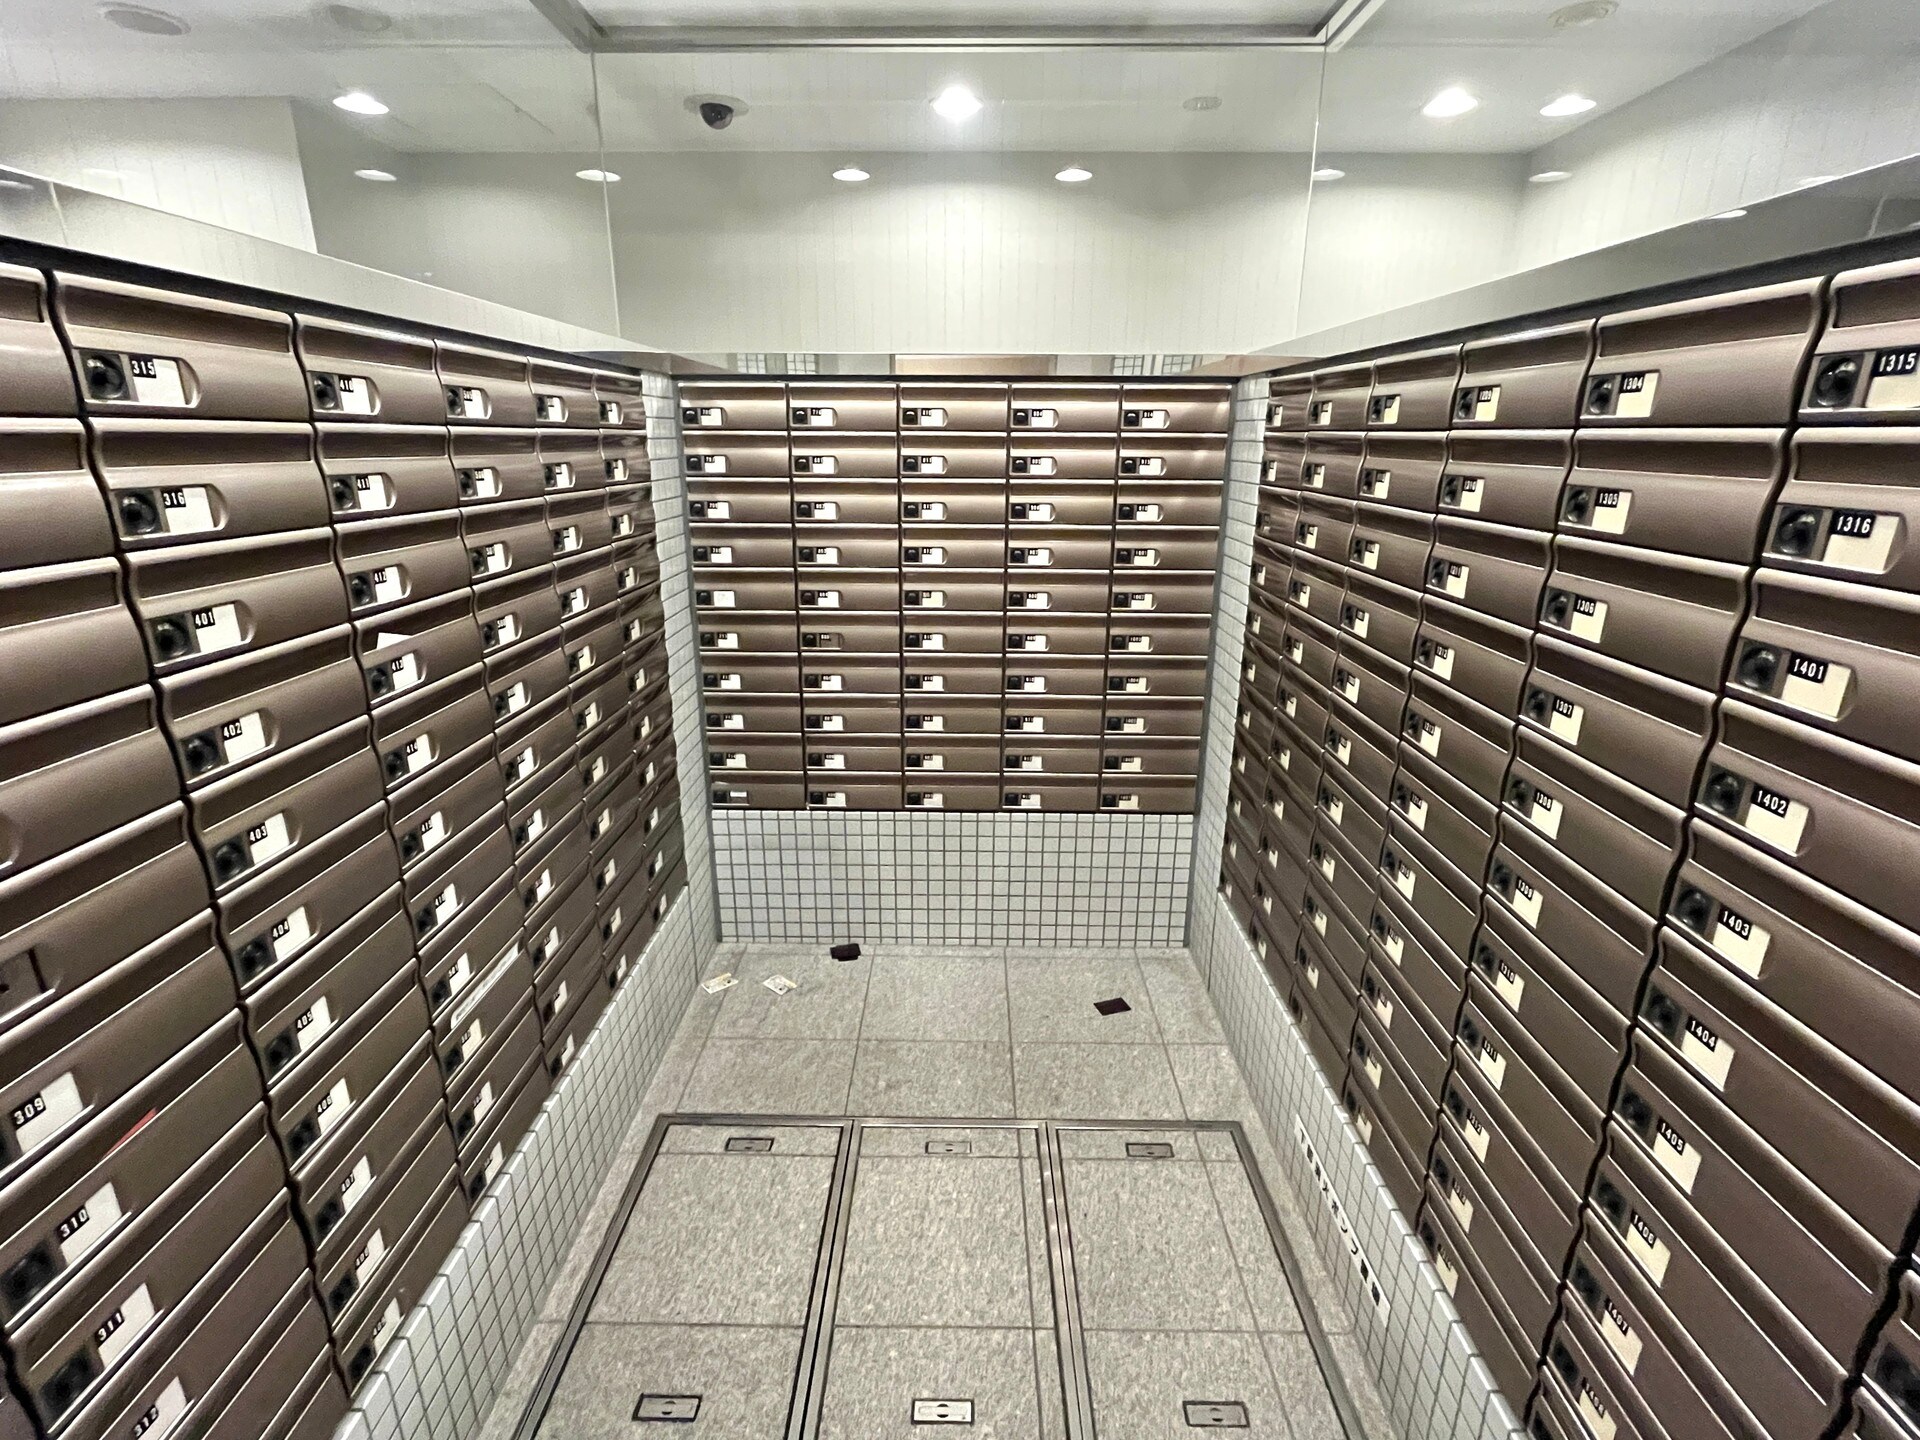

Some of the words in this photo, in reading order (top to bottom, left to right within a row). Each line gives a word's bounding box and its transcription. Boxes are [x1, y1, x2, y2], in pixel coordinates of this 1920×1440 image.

[131, 360, 155, 375] 315
[1878, 352, 1918, 374] 1315
[1623, 376, 1643, 390] 1304
[357, 478, 369, 489] 411
[163, 491, 185, 506] 316
[1598, 492, 1619, 506] 1305
[1836, 515, 1872, 535] 1316
[374, 570, 387, 583] 412
[1576, 599, 1595, 615] 1306
[194, 611, 214, 626] 401
[1793, 657, 1825, 680] 1401
[1555, 699, 1573, 716] 1307
[223, 722, 242, 738] 402
[1756, 789, 1788, 815] 1402
[249, 825, 267, 842] 403
[272, 920, 290, 938] 404
[1722, 910, 1750, 937] 1403
[1690, 1019, 1716, 1048] 1404
[13, 1096, 45, 1126] 309
[1660, 1122, 1684, 1151] 1405
[59, 1207, 89, 1238] 310
[97, 1311, 125, 1342] 311
[133, 1405, 159, 1438] 312
